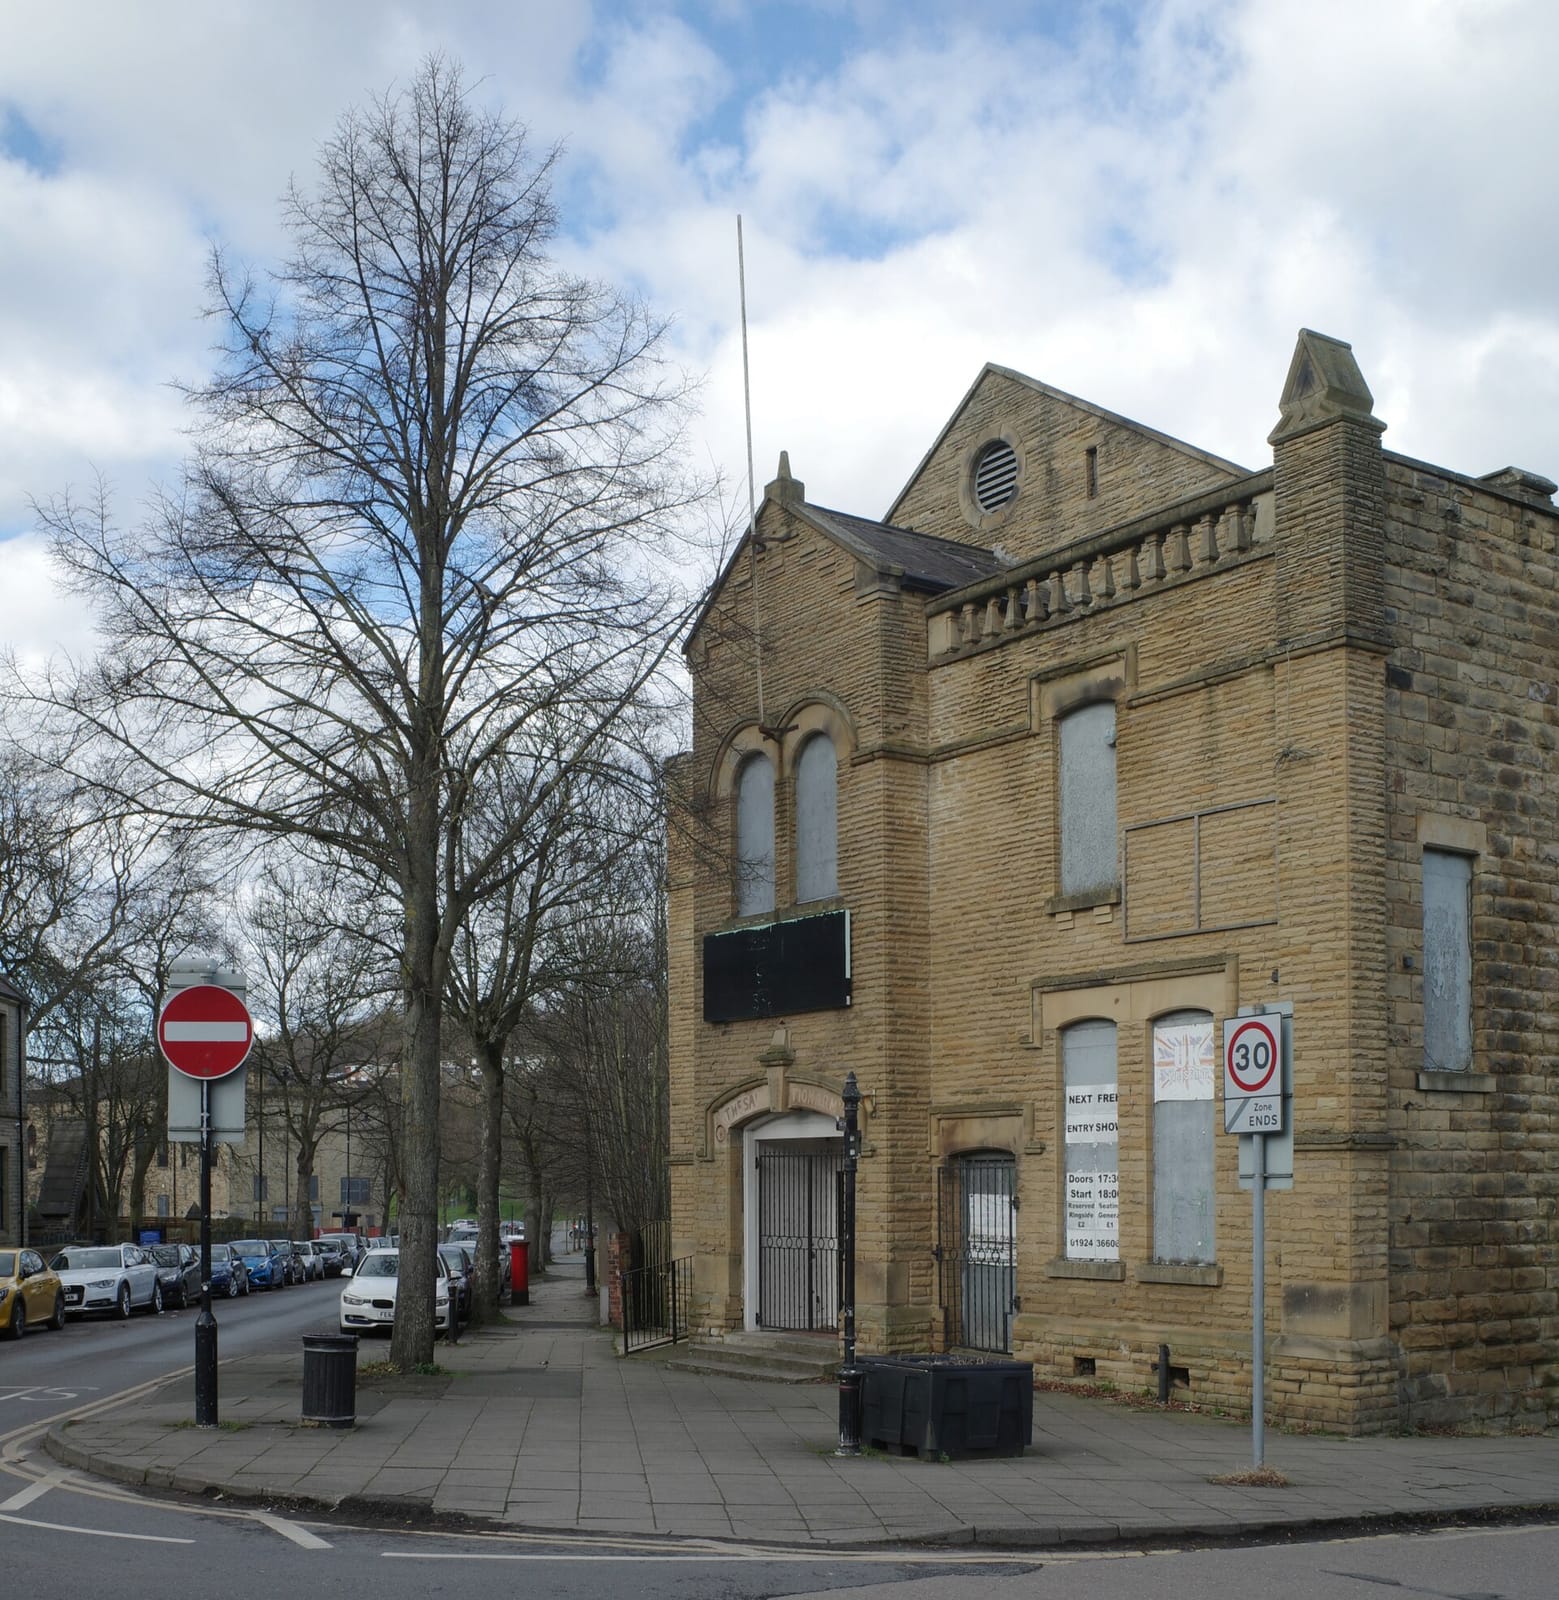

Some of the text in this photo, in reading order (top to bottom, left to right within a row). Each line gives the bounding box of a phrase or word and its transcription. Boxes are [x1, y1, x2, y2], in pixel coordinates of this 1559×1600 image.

[1235, 1042, 1269, 1071] 30
[1069, 1094, 1093, 1104] NEXT
[1254, 1103, 1272, 1112] Zone
[1249, 1114, 1278, 1127] ENDS
[1067, 1124, 1094, 1132] ENTRY
[1068, 1174, 1119, 1184] Doors 17:3
[1070, 1189, 1092, 1198] Start
[1070, 1239, 1093, 1247] 01924
